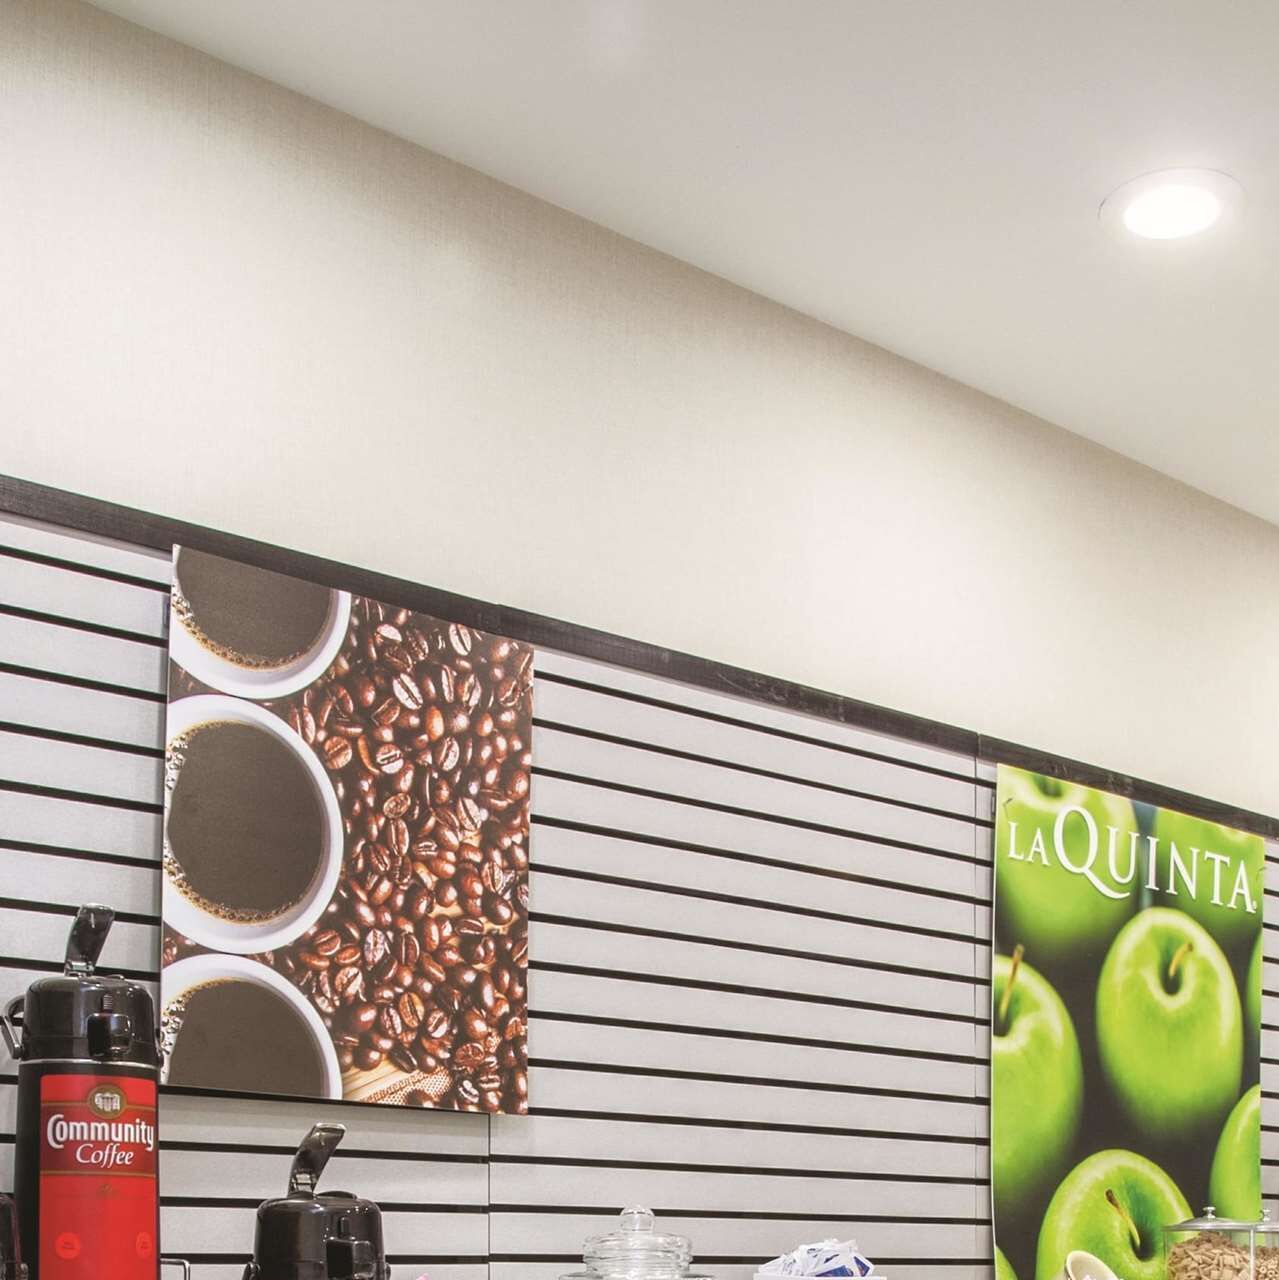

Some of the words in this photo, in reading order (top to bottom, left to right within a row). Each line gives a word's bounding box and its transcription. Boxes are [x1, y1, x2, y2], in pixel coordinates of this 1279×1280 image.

[1007, 821, 1052, 866] LA
[1053, 805, 1257, 914] QUINTA
[47, 1113, 154, 1152] Community
[75, 1142, 134, 1169] Coffee
